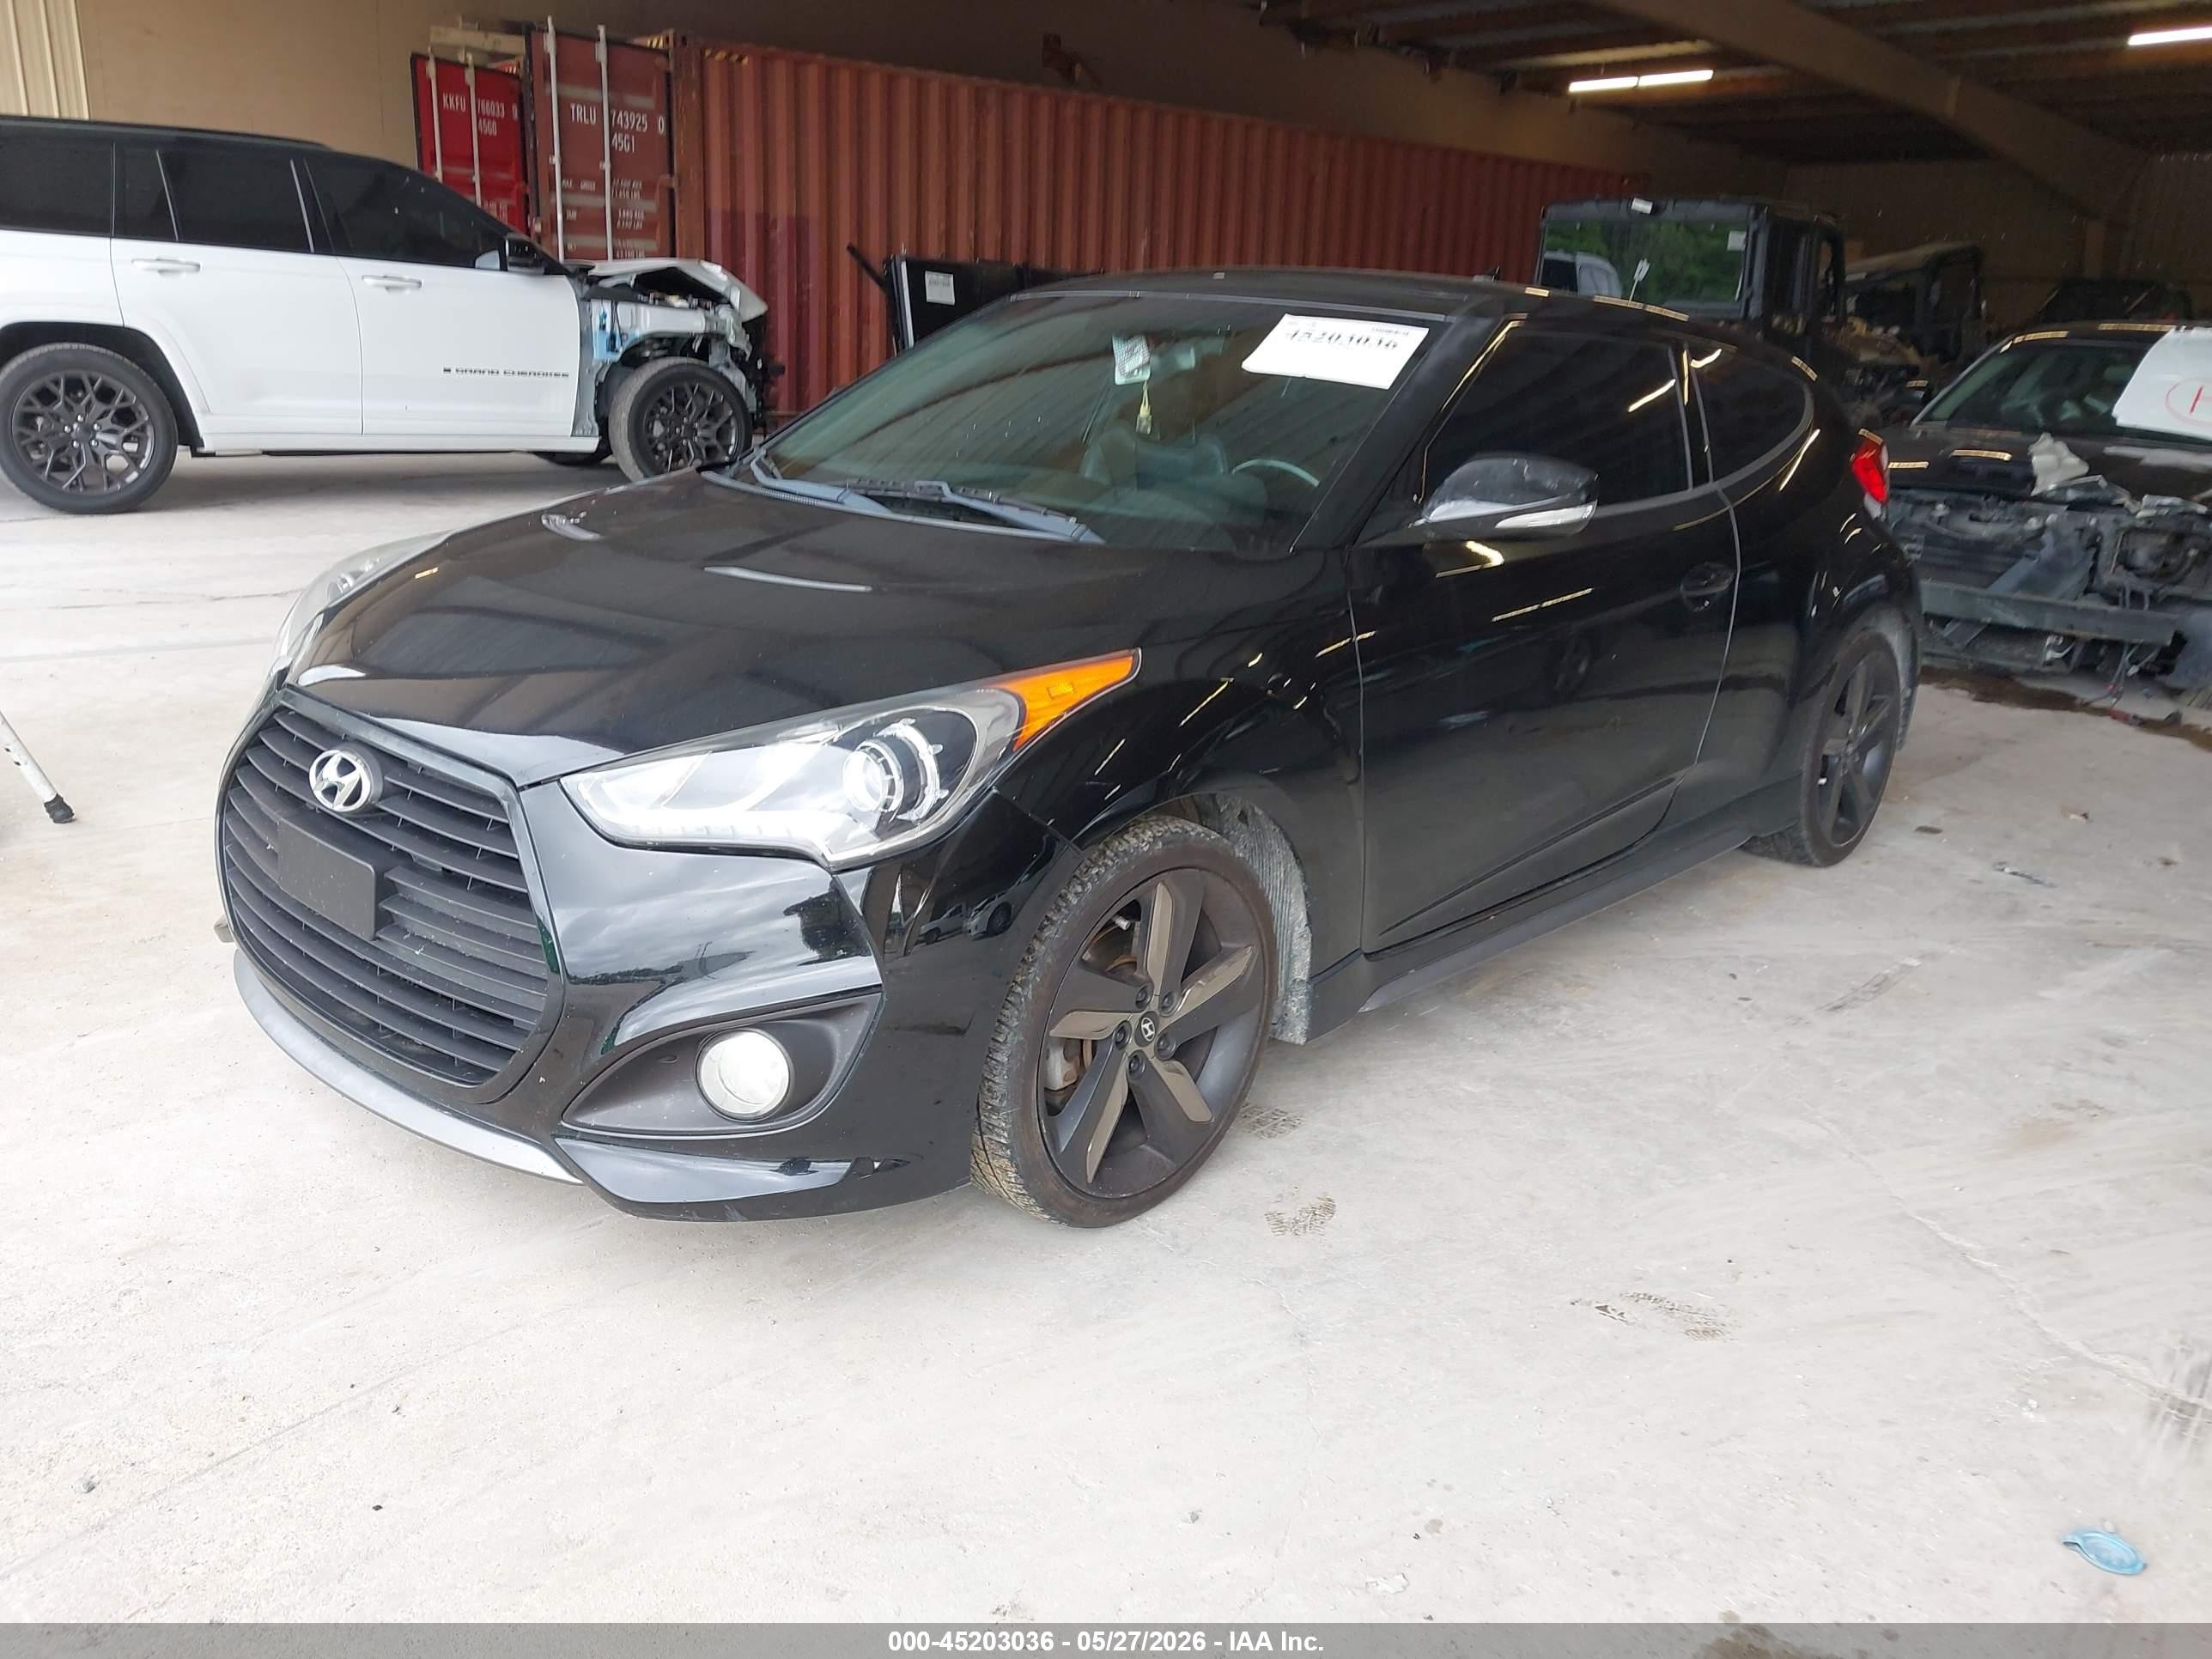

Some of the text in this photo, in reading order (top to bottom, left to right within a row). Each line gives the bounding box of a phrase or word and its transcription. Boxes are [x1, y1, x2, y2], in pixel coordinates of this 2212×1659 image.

[443, 92, 466, 112] KKFU
[570, 103, 597, 125] TRLU
[611, 108, 647, 132] 743925
[611, 132, 635, 154] 45G1
[455, 367, 569, 378] GRAND CHEROKEE
